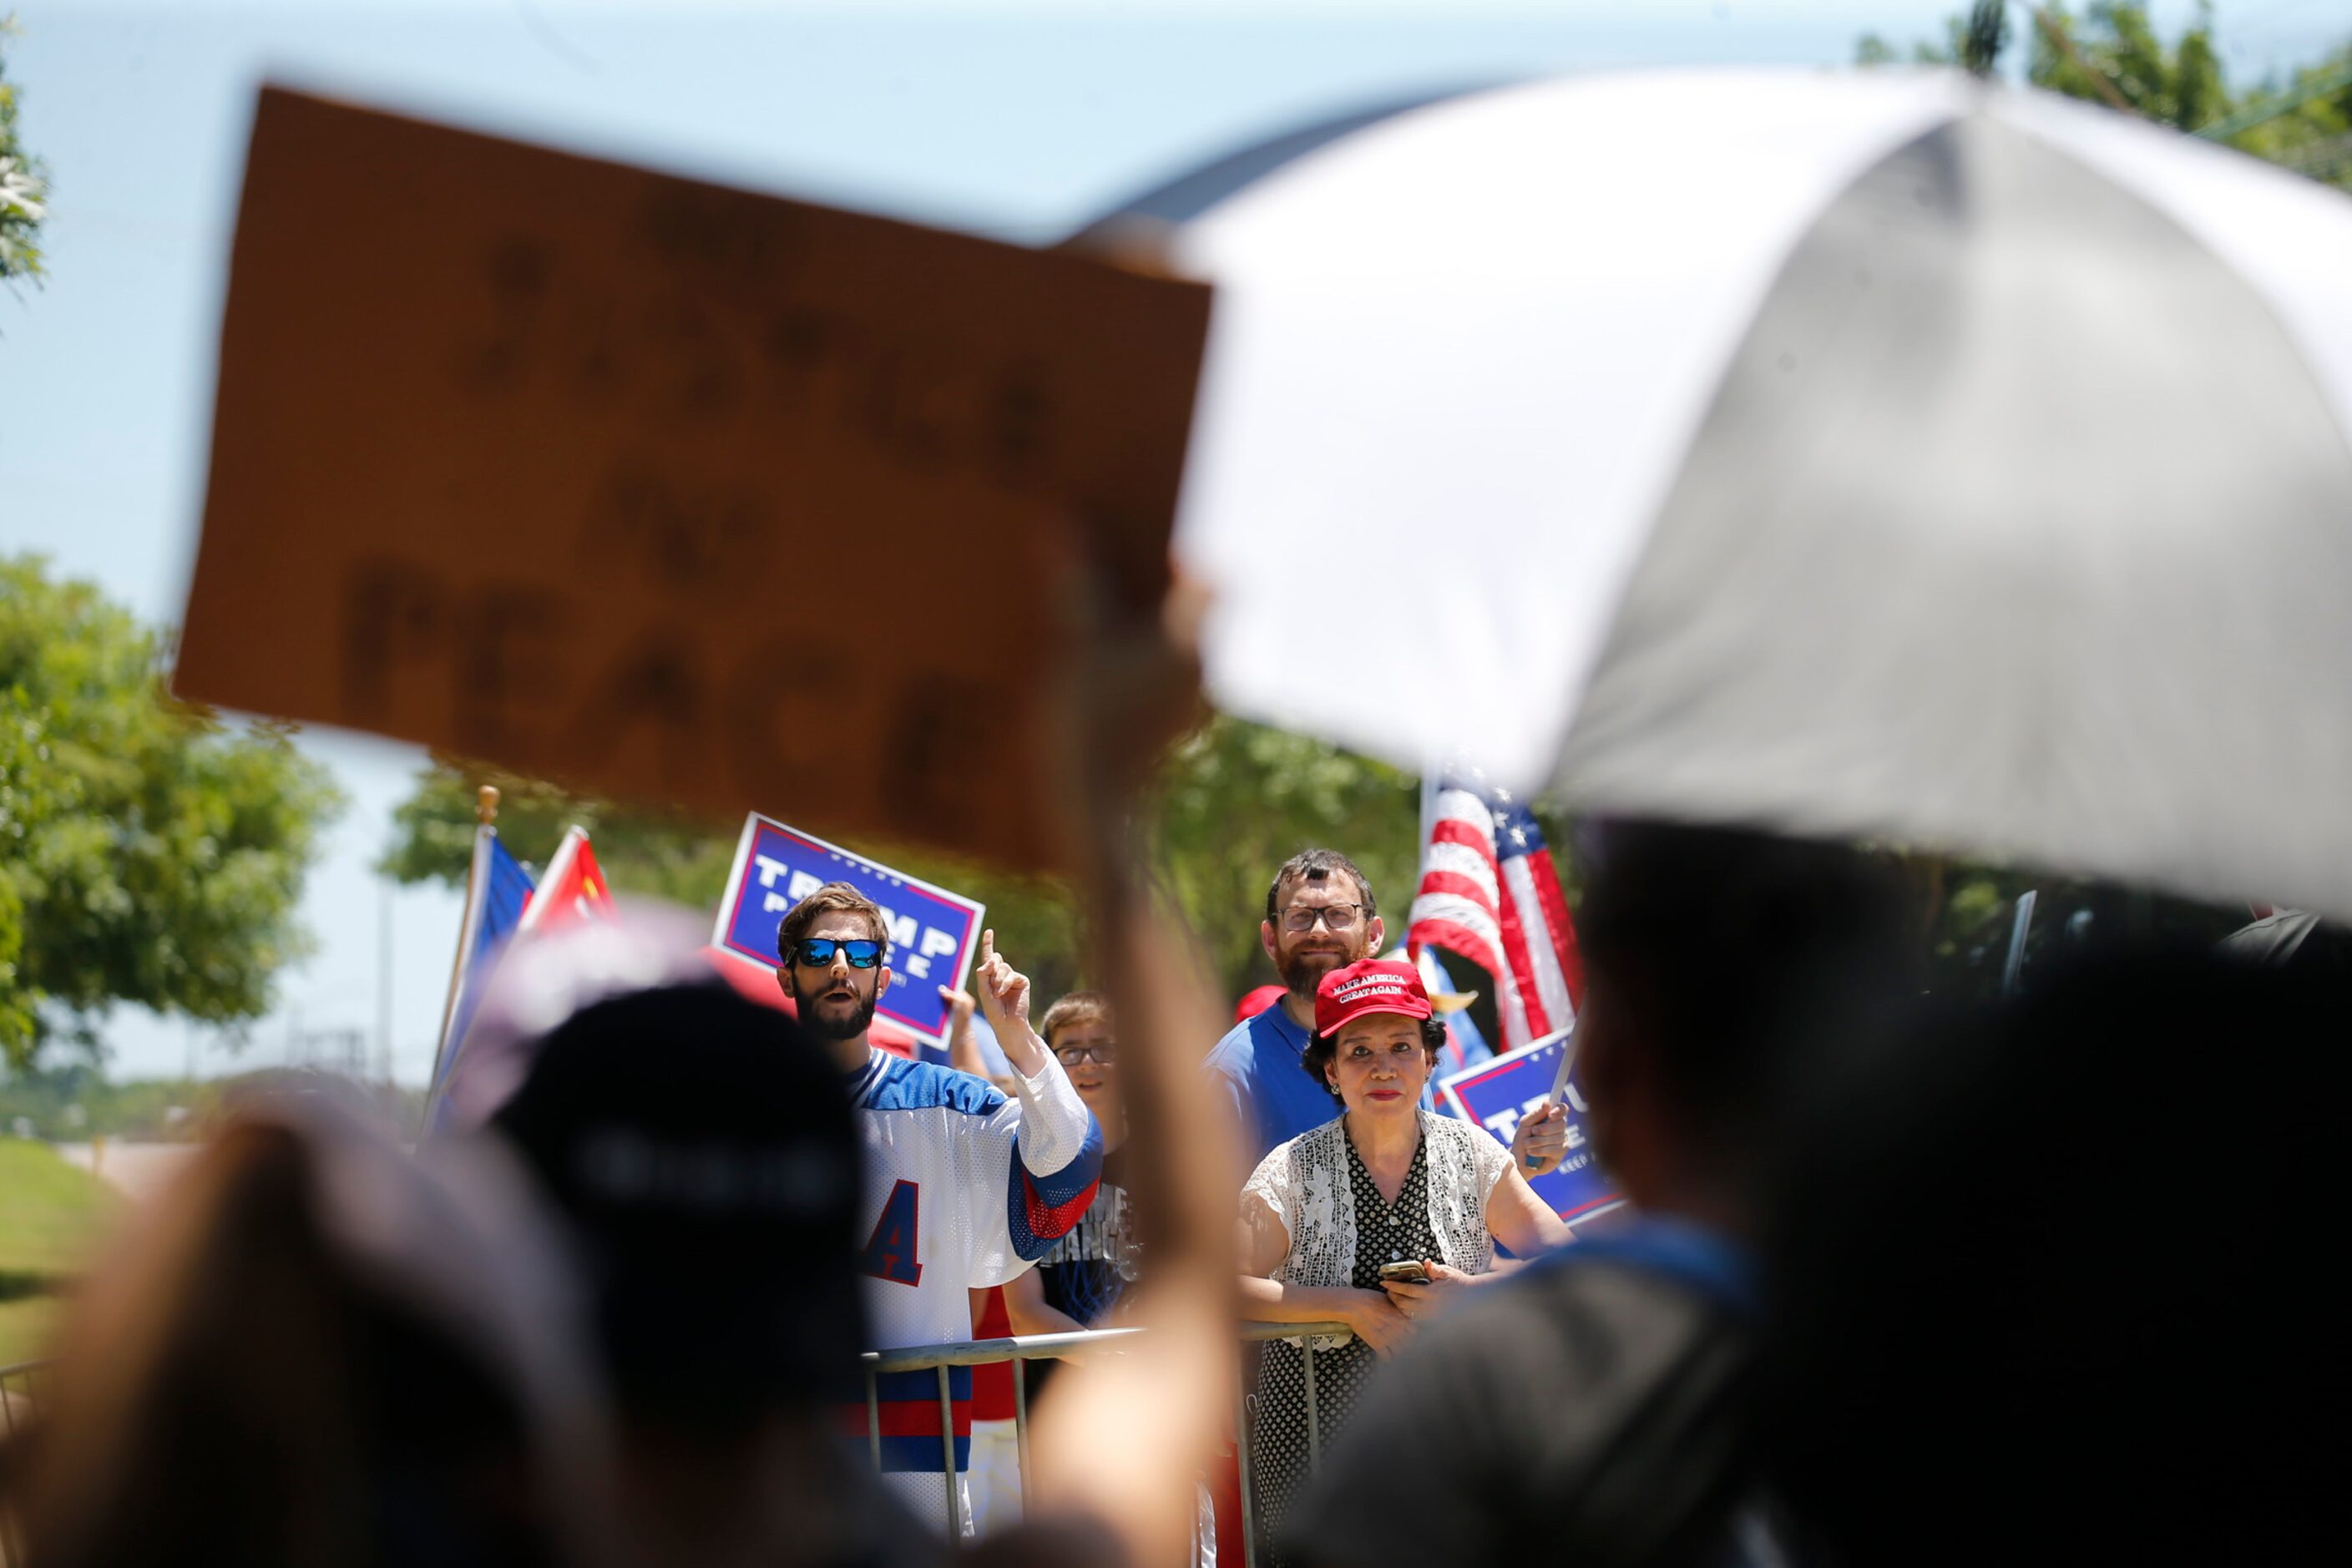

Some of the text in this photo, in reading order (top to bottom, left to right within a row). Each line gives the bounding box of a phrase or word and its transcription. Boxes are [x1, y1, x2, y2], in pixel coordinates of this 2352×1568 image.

[755, 853, 958, 959] TRMP
[1333, 974, 1407, 996] MAKE AMERICA
[1339, 985, 1402, 1004] GREAT AGAIN
